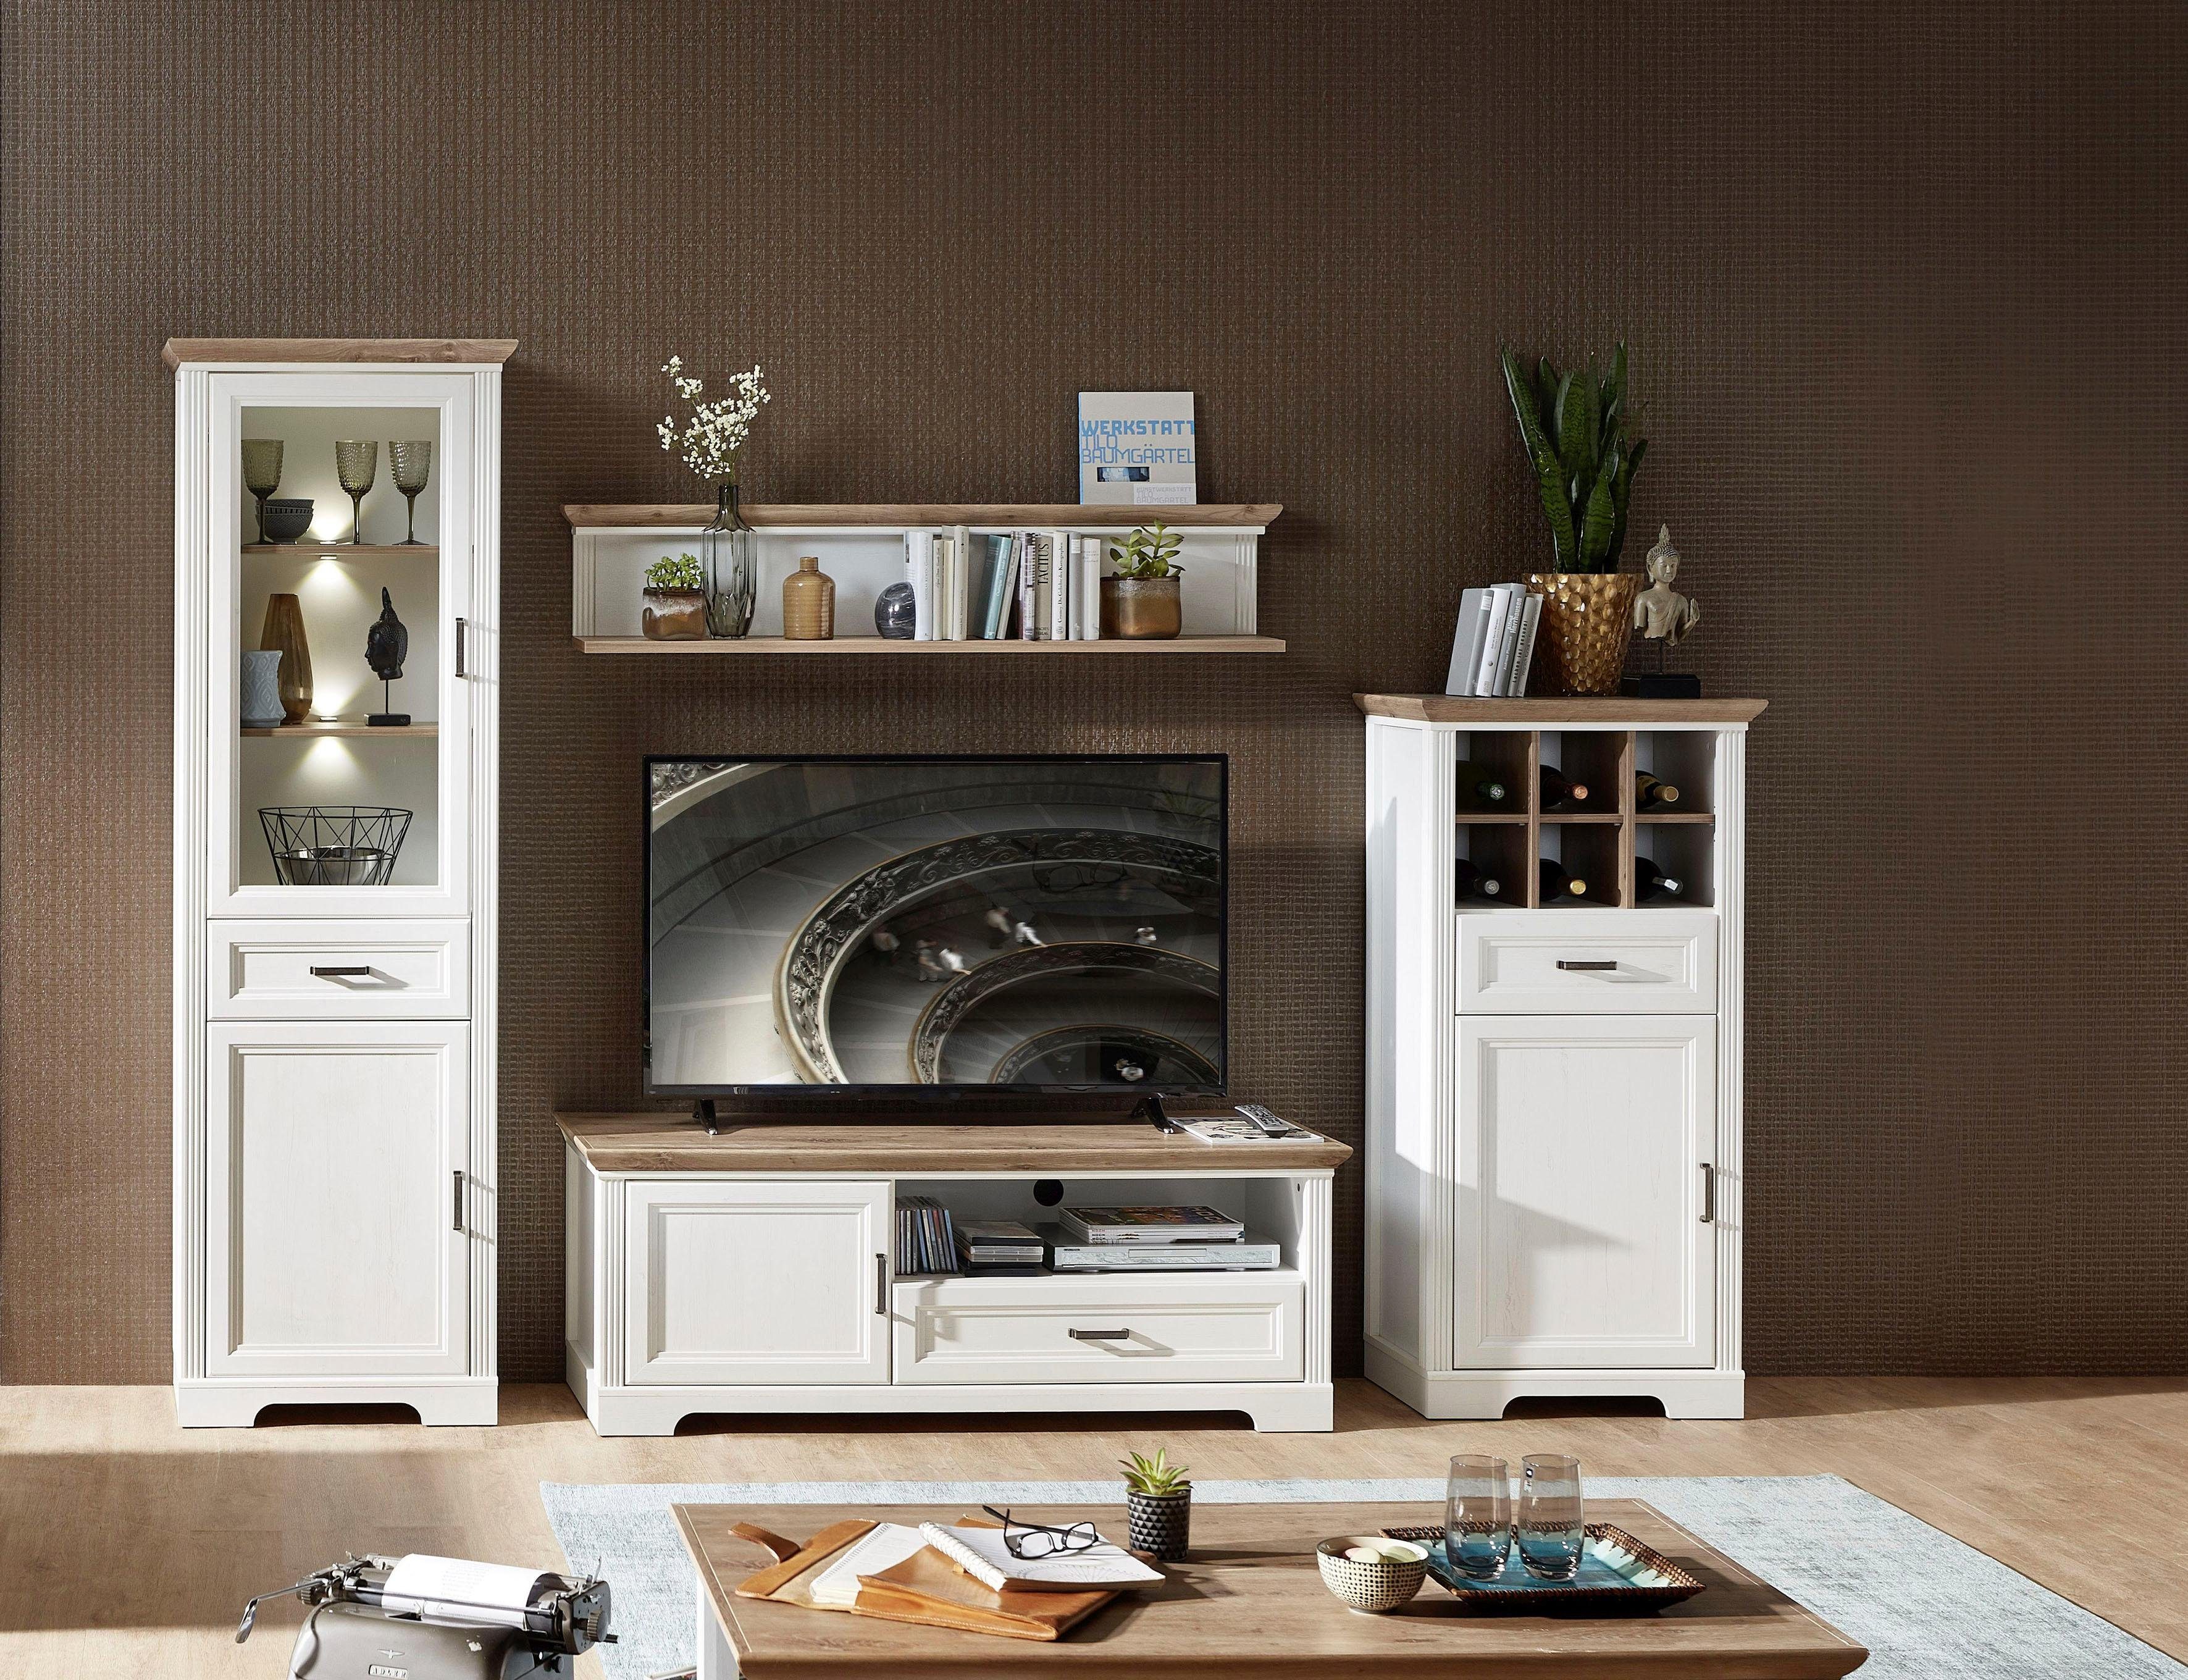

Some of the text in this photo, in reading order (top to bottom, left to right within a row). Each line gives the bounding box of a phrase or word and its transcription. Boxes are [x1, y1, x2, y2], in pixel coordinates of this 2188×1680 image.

[1081, 420, 1194, 435] WERKSTATT
[1082, 434, 1118, 449] TILO
[1082, 443, 1196, 464] BAUMGÄRTEL
[1037, 544, 1049, 586] TACITUS
[1509, 597, 1522, 634] Herrhausen
[1512, 660, 1521, 683] Lachen
